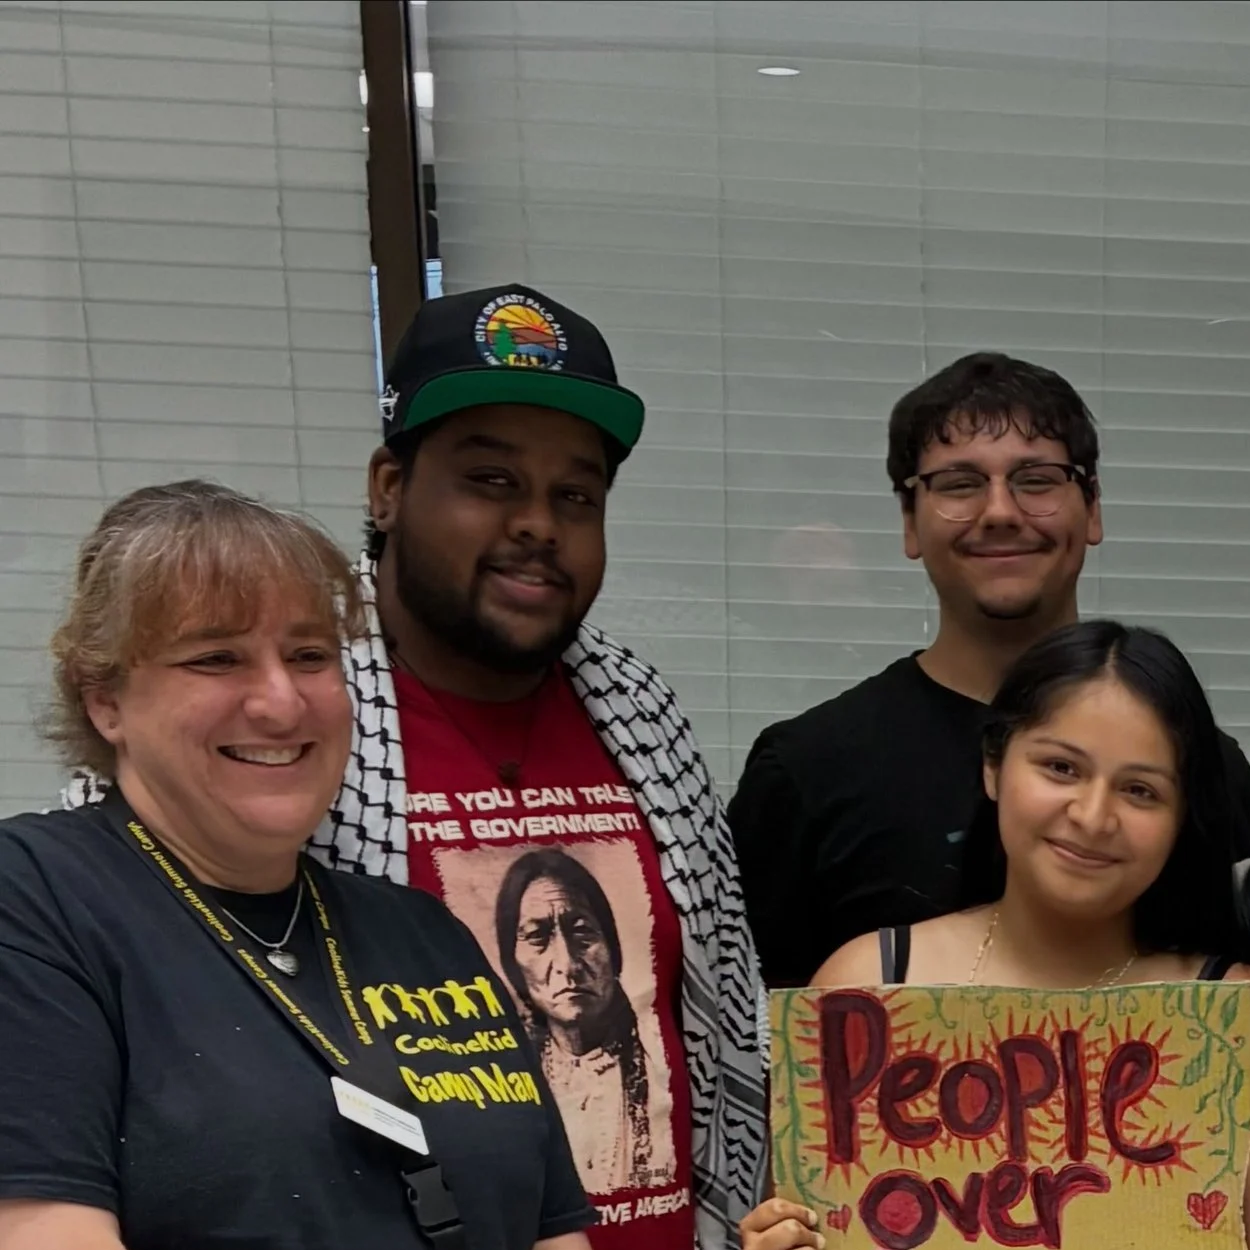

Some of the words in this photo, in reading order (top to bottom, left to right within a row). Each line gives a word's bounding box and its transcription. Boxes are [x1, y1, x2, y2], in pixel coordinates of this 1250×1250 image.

[475, 316, 487, 342] CITY
[496, 294, 525, 306] EAST
[455, 787, 516, 812] YOU
[520, 784, 577, 808] CAN
[408, 820, 465, 842] THE
[469, 812, 642, 840] GOVERNMENT!
[399, 1066, 486, 1109] Camp
[818, 988, 1181, 1167] People
[858, 1159, 1112, 1250] over
